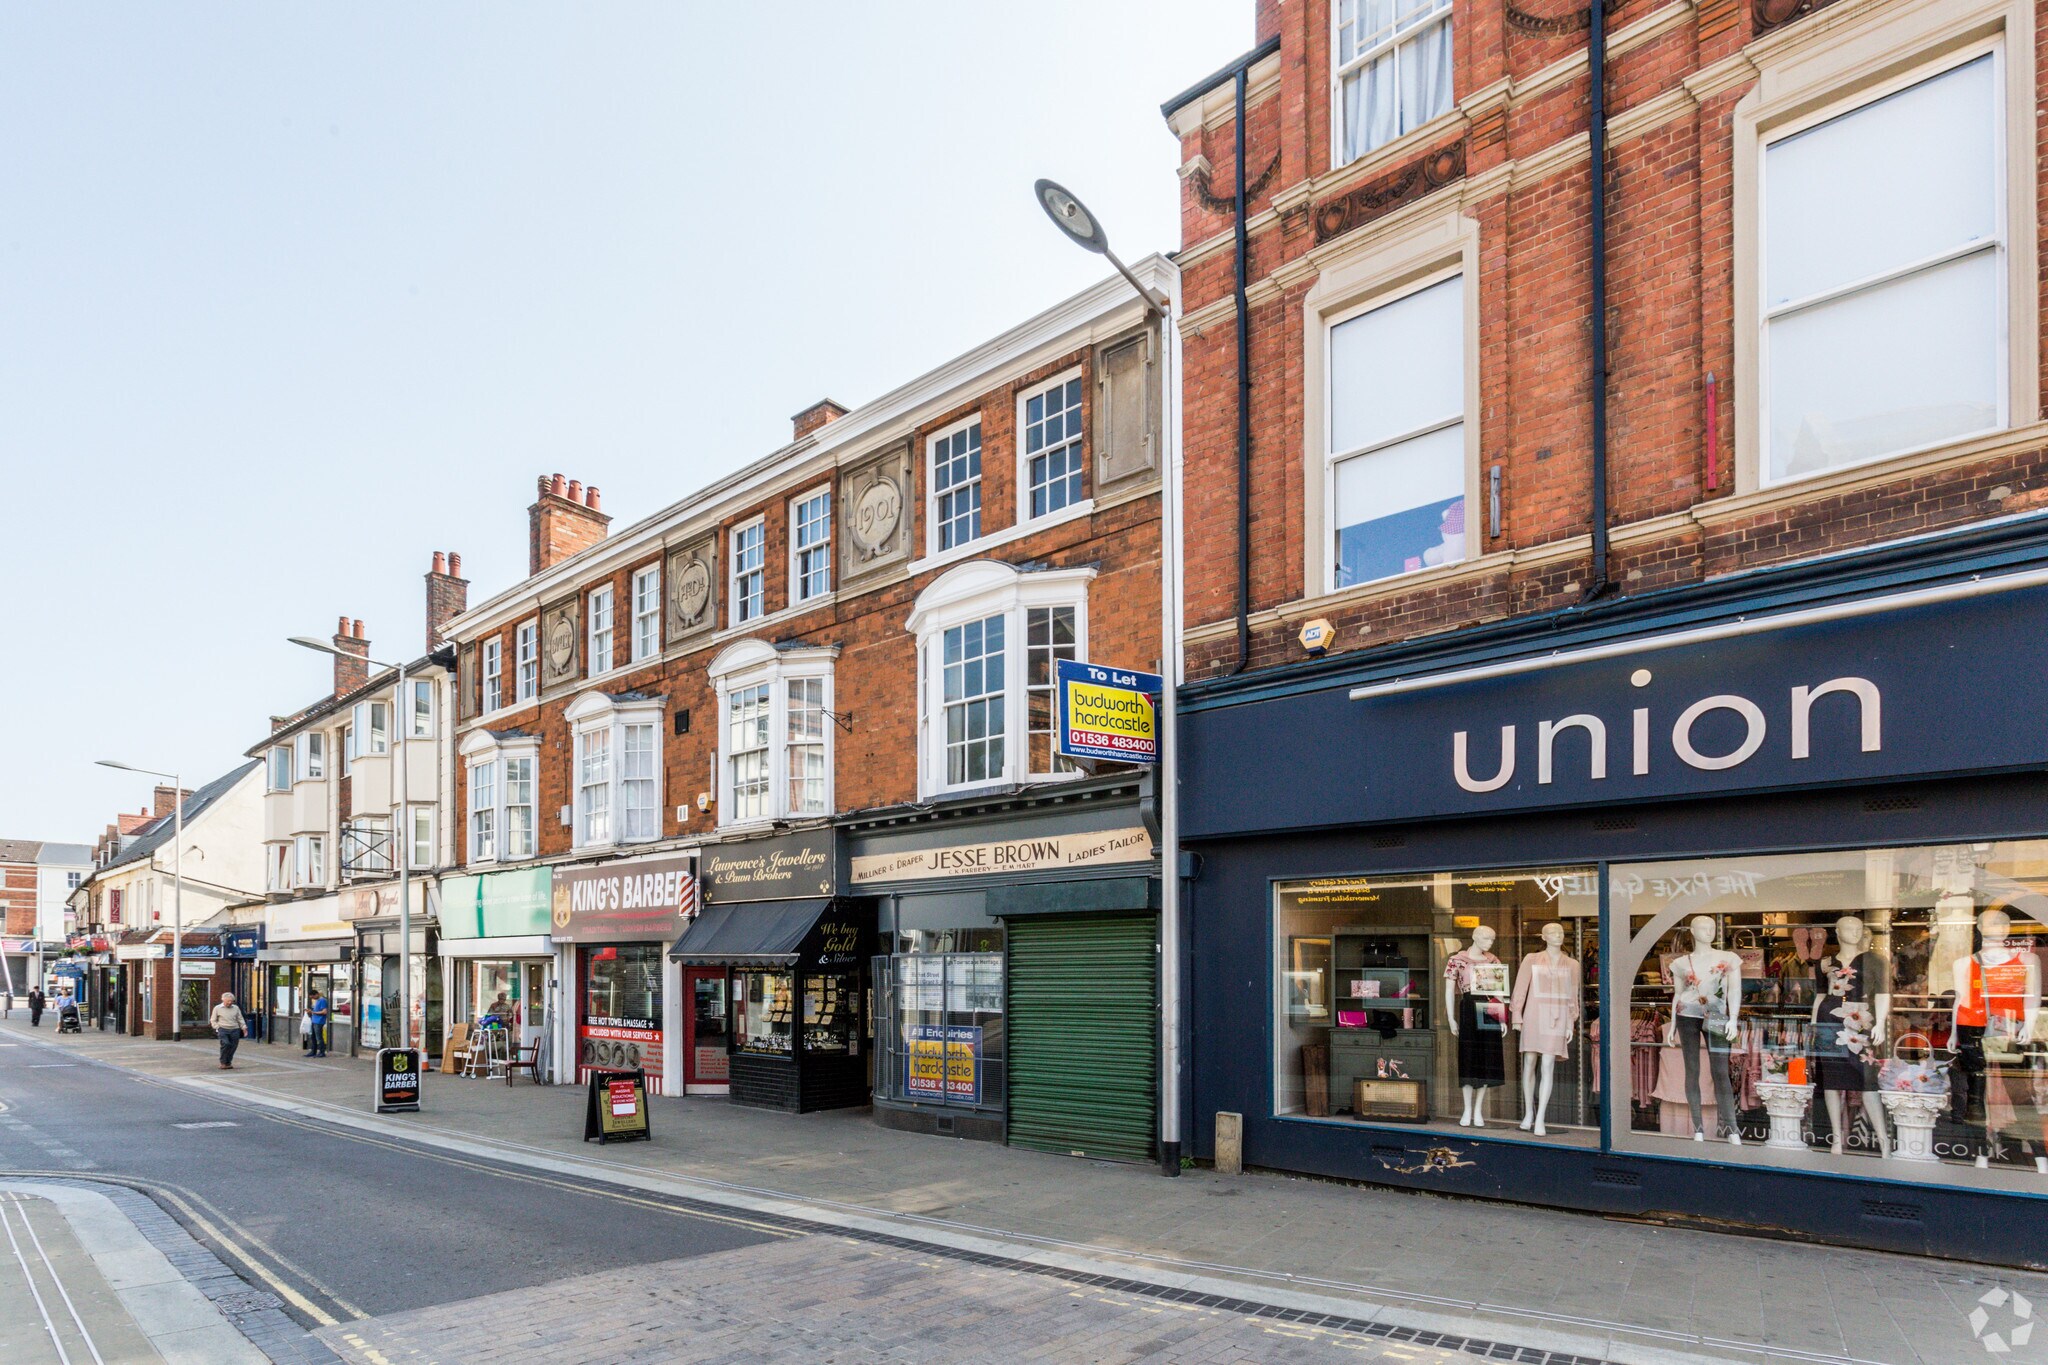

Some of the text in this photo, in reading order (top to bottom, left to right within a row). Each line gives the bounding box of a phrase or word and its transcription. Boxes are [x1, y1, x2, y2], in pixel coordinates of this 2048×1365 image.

[858, 496, 895, 535] 1901
[1305, 629, 1320, 640] ADT
[1088, 667, 1137, 686] To Let
[1074, 689, 1144, 715] budworth
[1075, 707, 1151, 733] hardcastle
[1454, 669, 1881, 793] union
[1072, 731, 1154, 751] 01536 483400
[1070, 746, 1156, 761] www.budworthhardcastle.com
[1108, 832, 1144, 851] TAILOR
[705, 847, 826, 876] Lawrence's Jewellers
[928, 840, 1060, 870] JESSE BROWN
[714, 867, 792, 885] & Pawn Brokers
[857, 866, 887, 881] MILLINER
[572, 876, 620, 912] KING'S
[820, 922, 859, 938] We buy
[823, 936, 857, 952] Gold
[818, 952, 857, 964] & Silver
[588, 1016, 598, 1025] FREE
[598, 1017, 608, 1026] HOT
[608, 1017, 623, 1027] TOWEL
[627, 1019, 647, 1029] MASSAGE
[589, 1028, 653, 1040] INCLUDED WITH OUR SERVICES
[911, 1028, 923, 1036] All
[384, 1081, 418, 1089] BARBER
[385, 1073, 417, 1082] KING'S
[911, 1078, 973, 1092] 01536 43400
[1693, 1123, 2009, 1160] www.union-clothingco.uk
